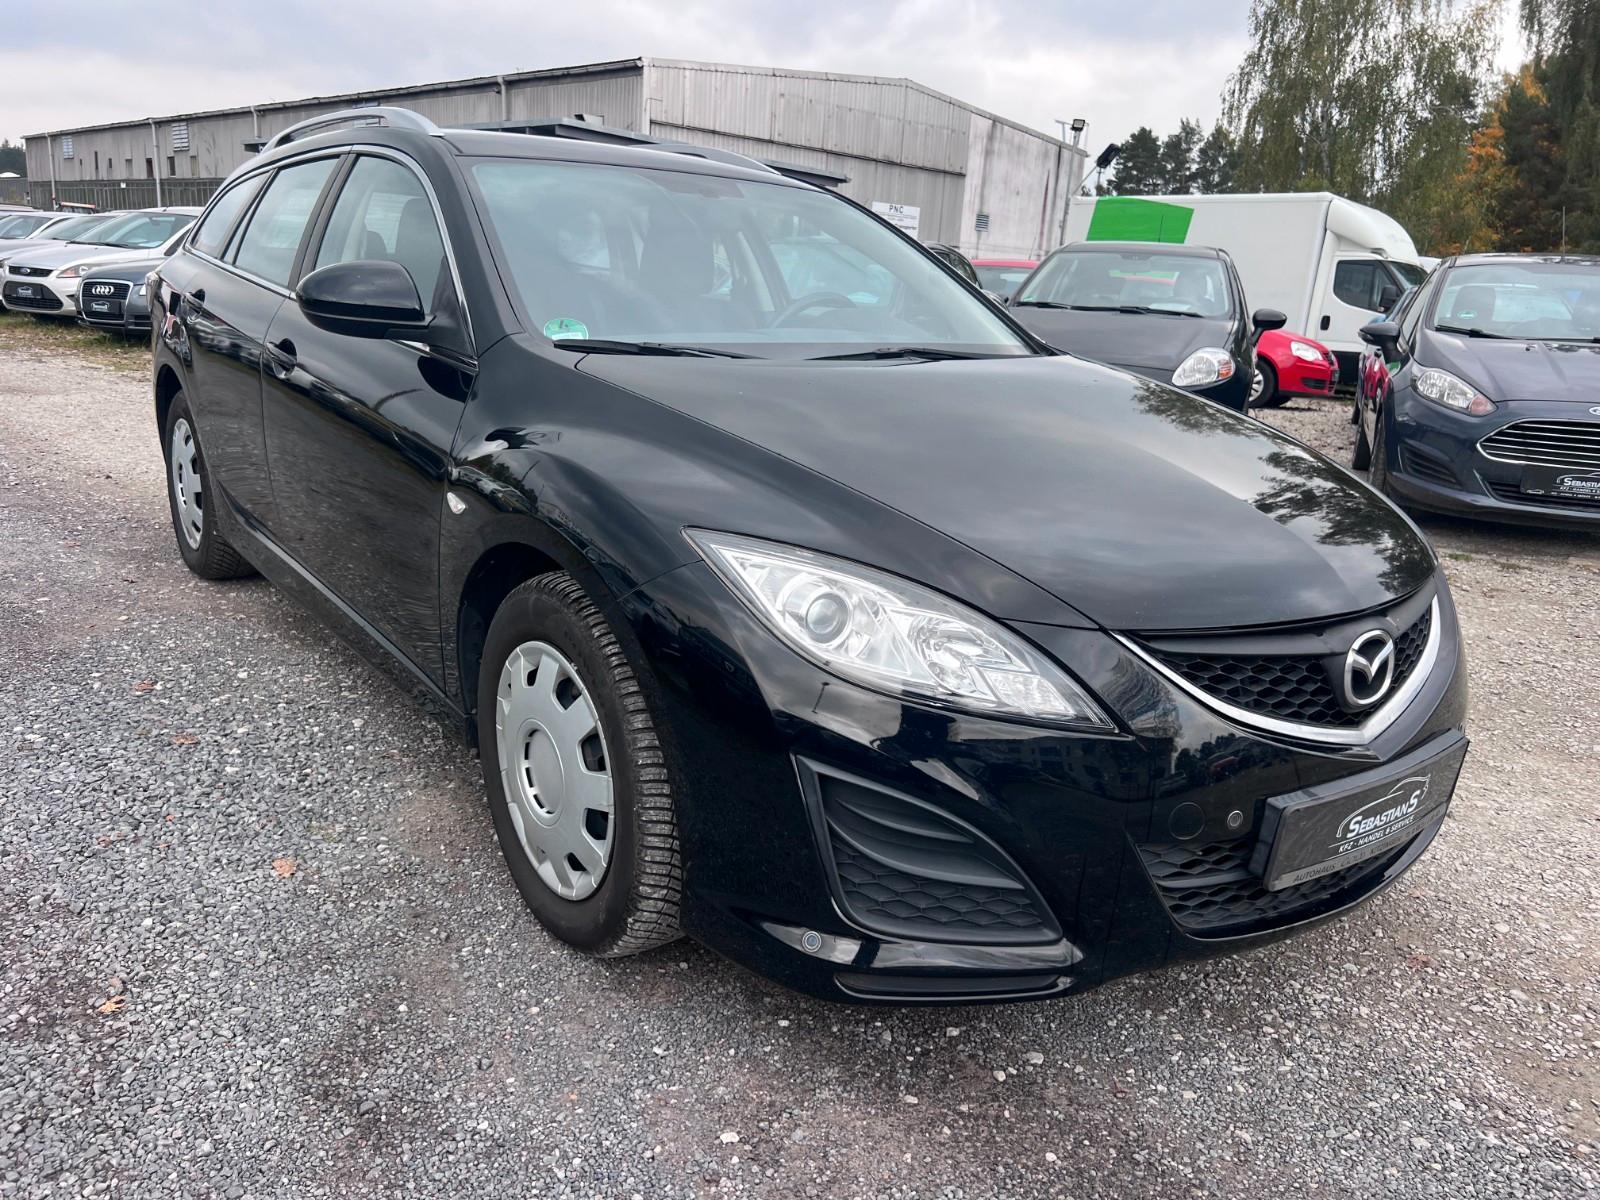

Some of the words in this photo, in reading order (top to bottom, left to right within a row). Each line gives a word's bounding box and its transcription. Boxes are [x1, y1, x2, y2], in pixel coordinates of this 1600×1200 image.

[888, 204, 904, 213] PNC
[1338, 841, 1354, 853] KFZ
[1357, 830, 1384, 846] HANDEL
[1391, 814, 1415, 832] SERVICE
[1346, 789, 1421, 839] SEBASTIANS
